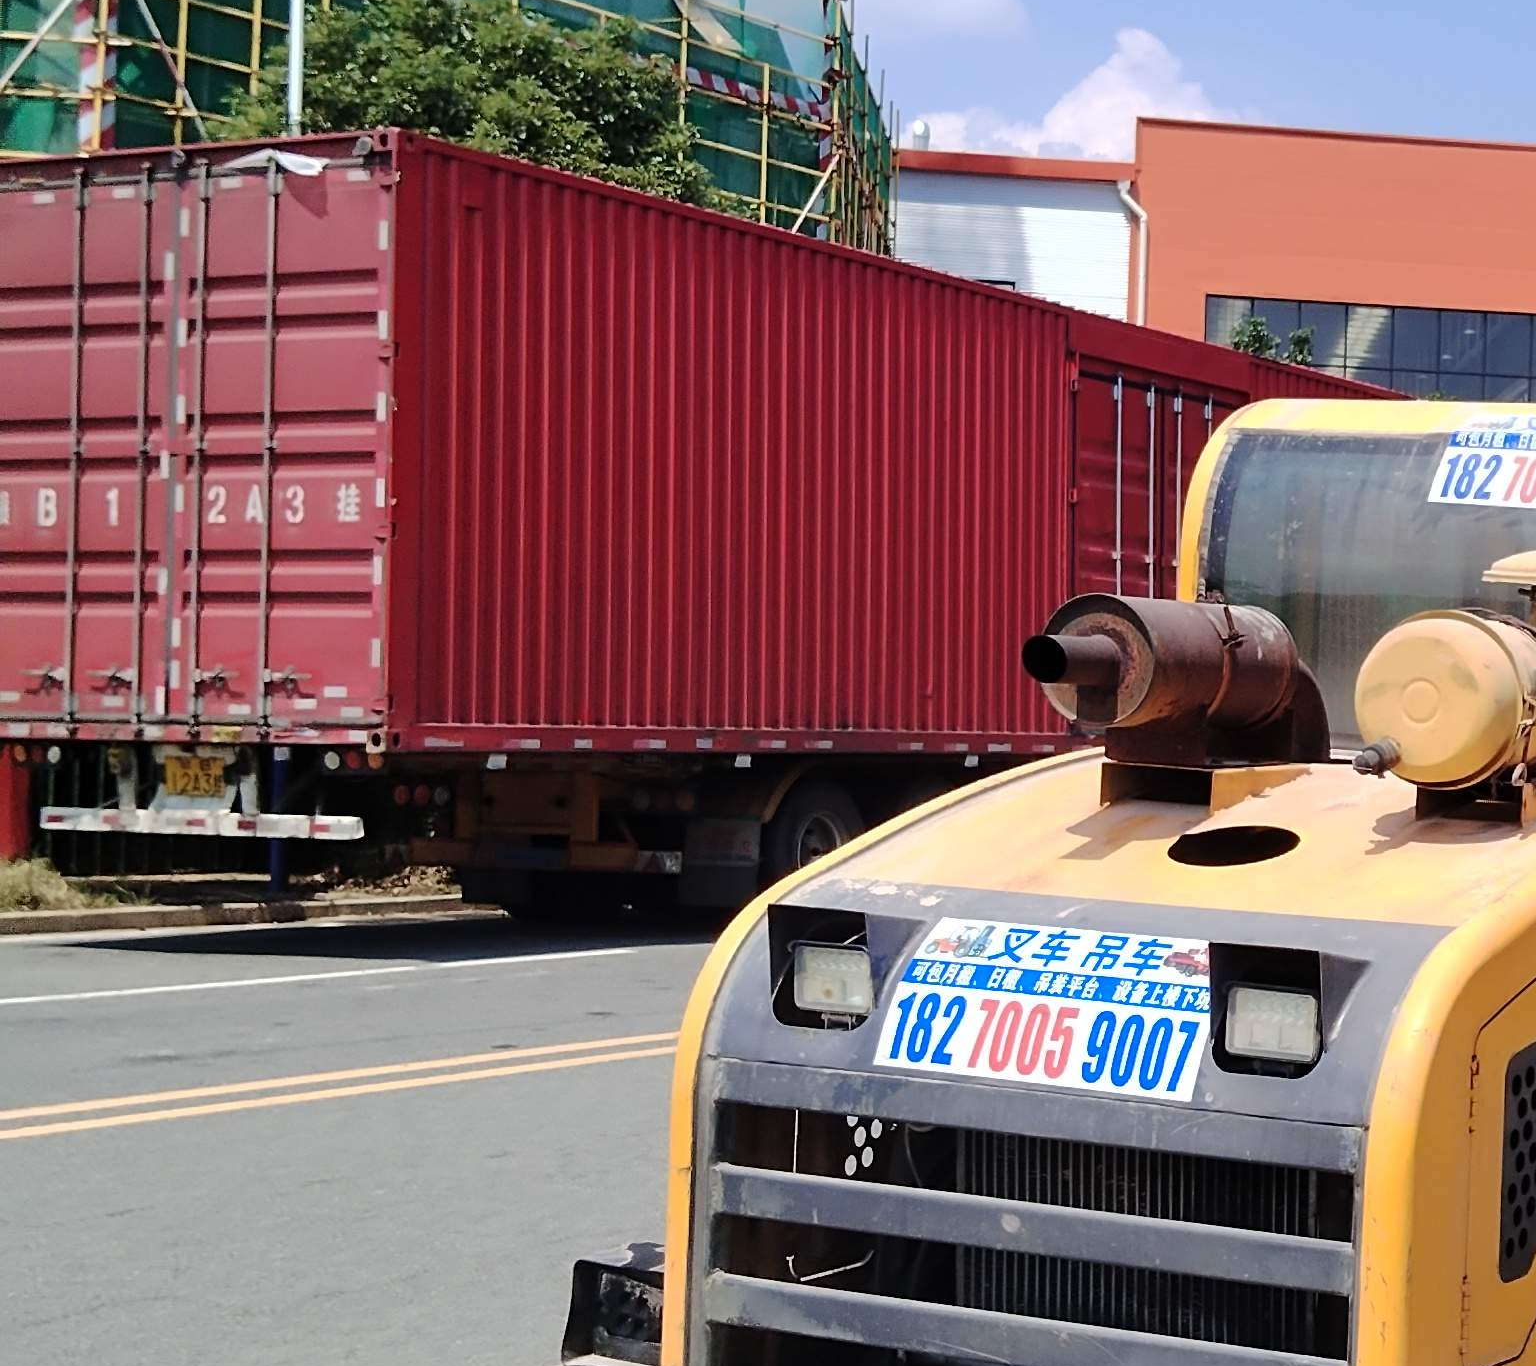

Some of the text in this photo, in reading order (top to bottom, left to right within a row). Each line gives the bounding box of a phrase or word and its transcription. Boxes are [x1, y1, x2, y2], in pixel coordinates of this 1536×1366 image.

[1440, 452, 1504, 501] 182
[988, 928, 1174, 977] 叉车 吊车
[889, 991, 1201, 1093] 182 7005 9007
